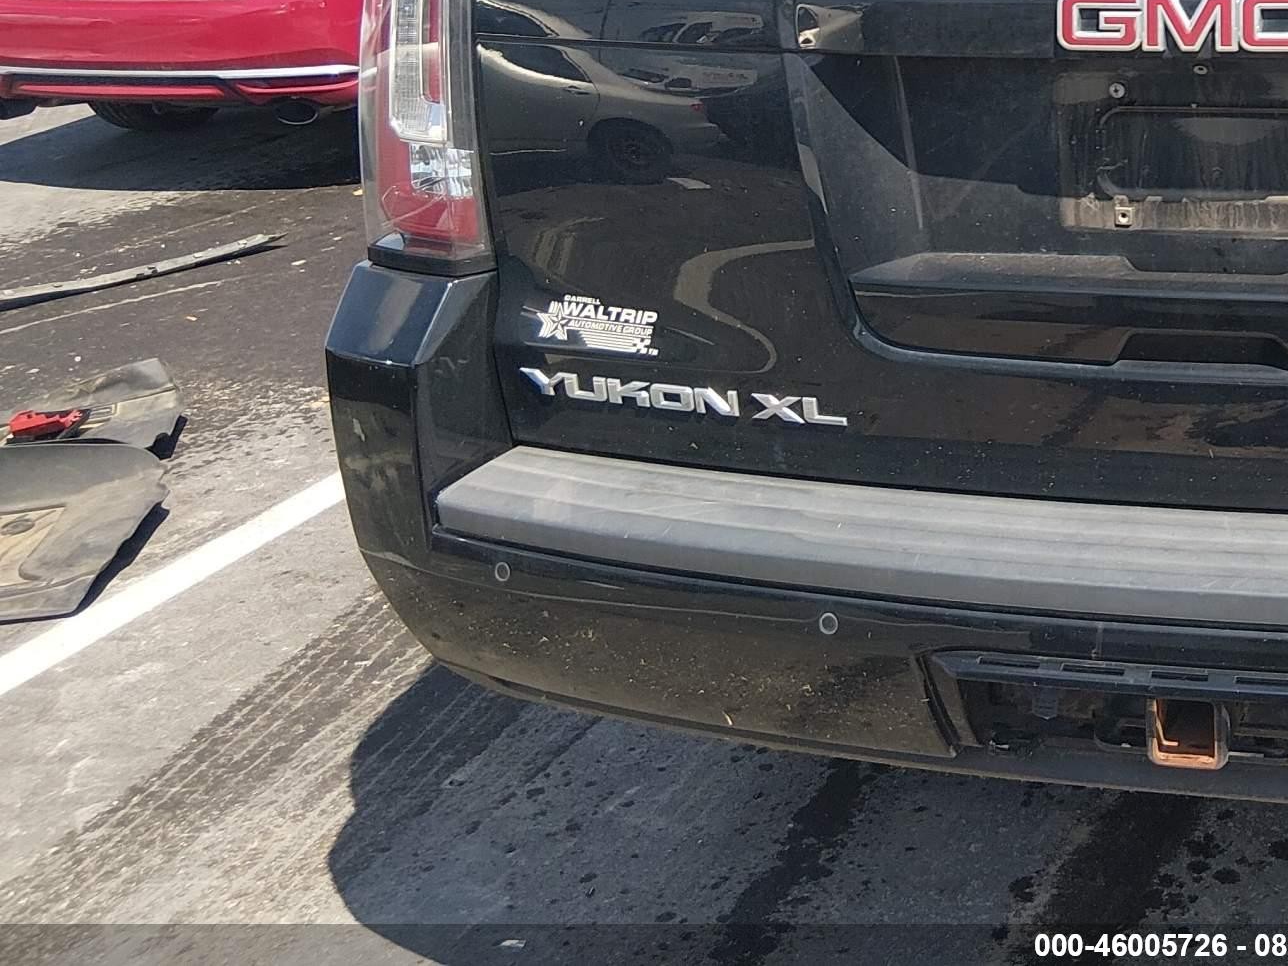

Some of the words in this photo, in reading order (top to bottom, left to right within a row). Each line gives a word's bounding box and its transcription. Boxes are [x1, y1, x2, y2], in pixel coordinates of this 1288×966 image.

[563, 301, 659, 325] WALTRIP
[567, 319, 623, 334] AUTOMOTIVE
[622, 325, 653, 337] GROUP
[518, 367, 740, 418] YUKON
[751, 392, 848, 427] XL
